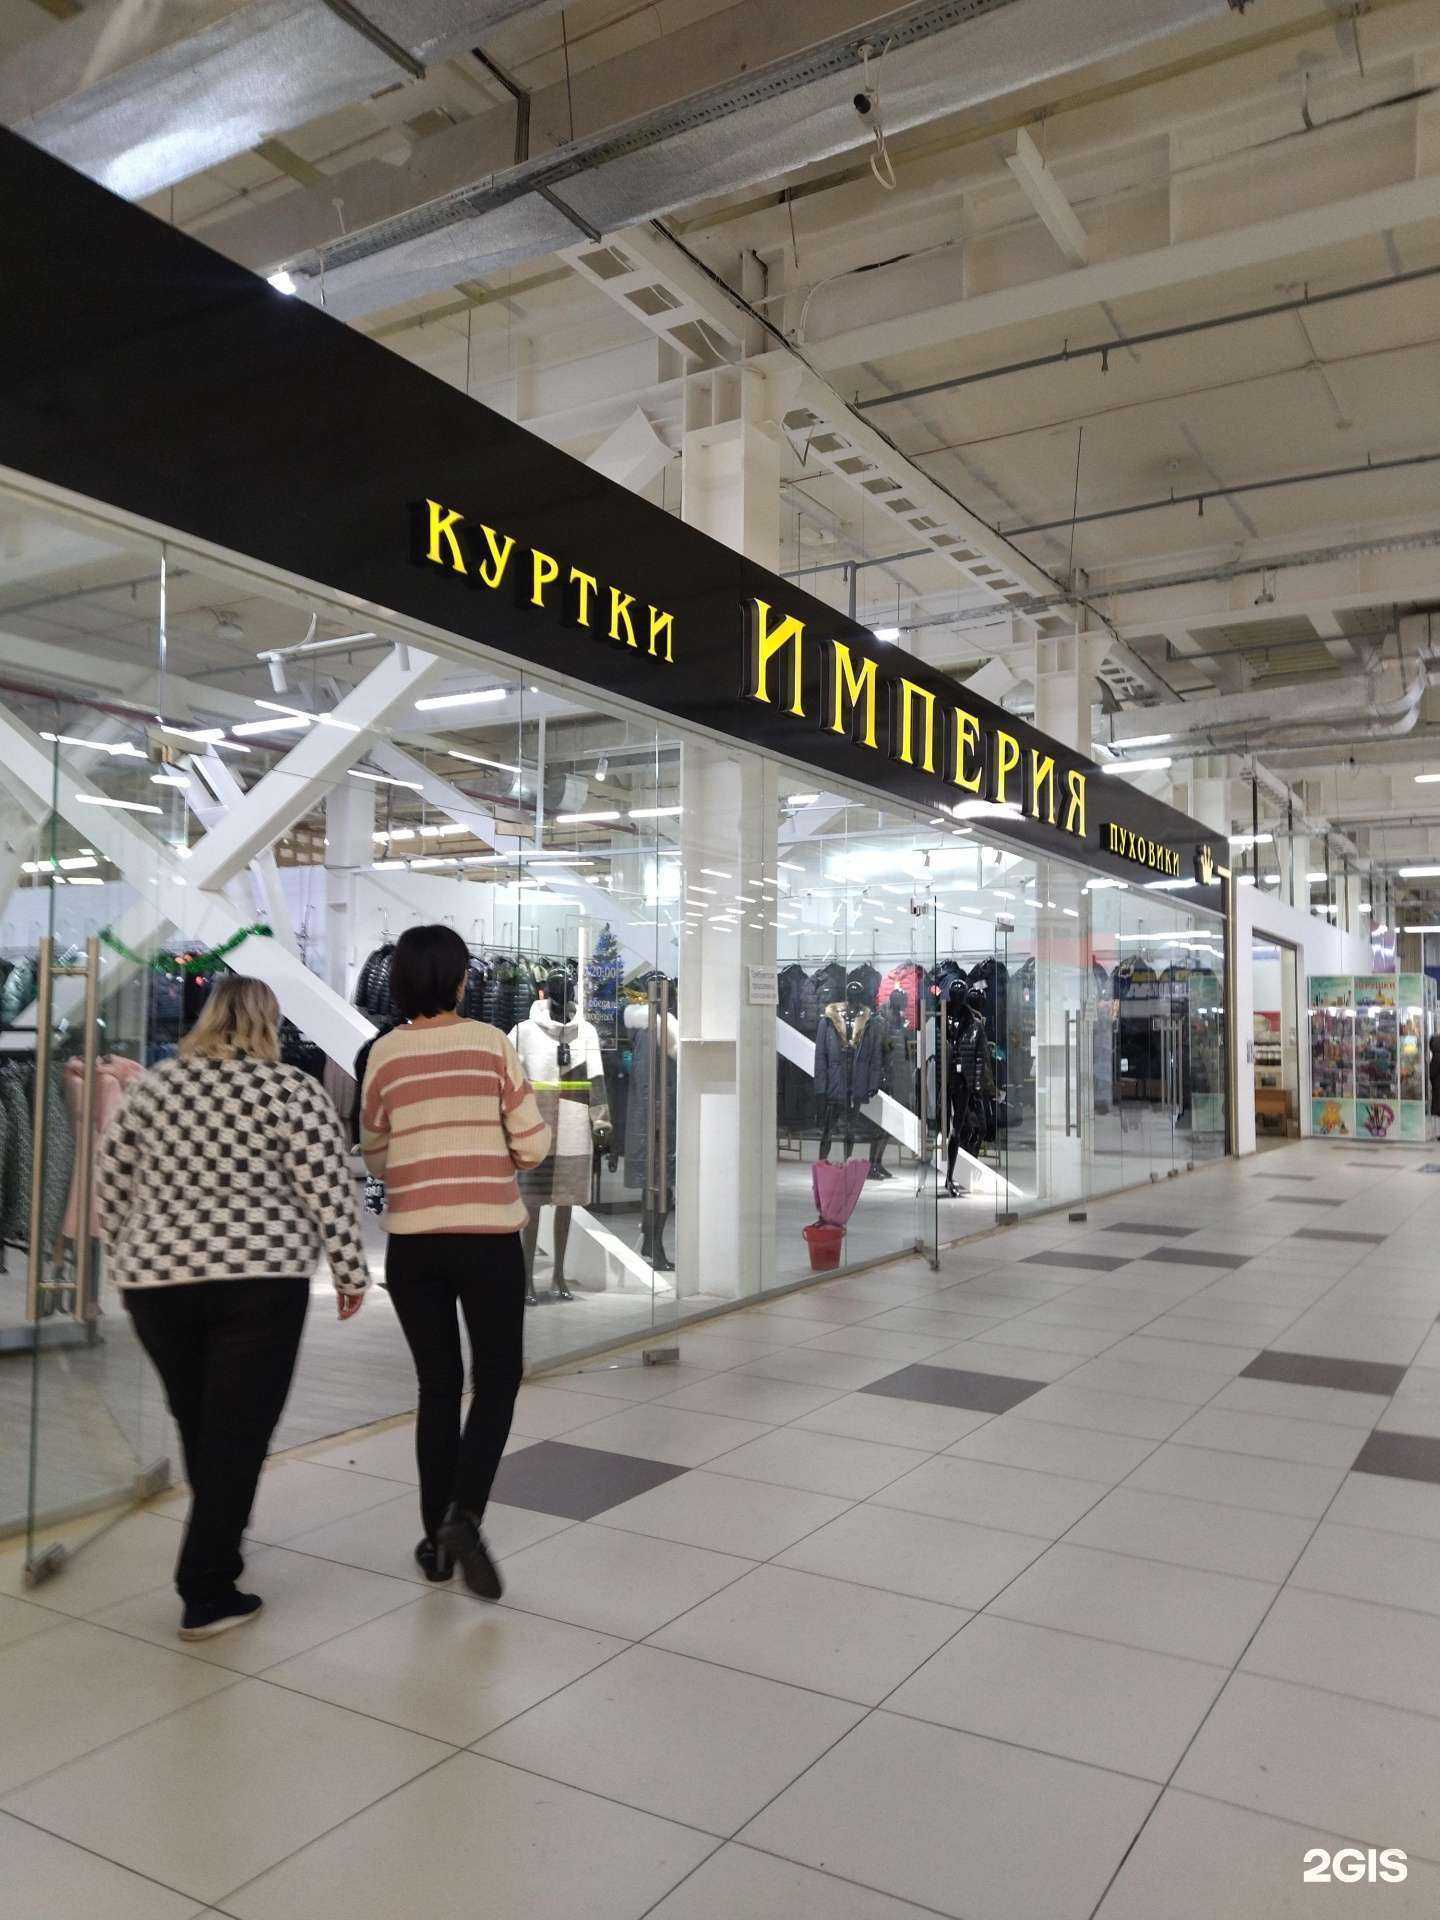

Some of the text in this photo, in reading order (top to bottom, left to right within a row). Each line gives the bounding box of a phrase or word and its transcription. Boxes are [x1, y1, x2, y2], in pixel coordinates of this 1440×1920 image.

[426, 498, 1179, 877] КУРТКИ ИМПЕРИЯ ПУХОВИКИ
